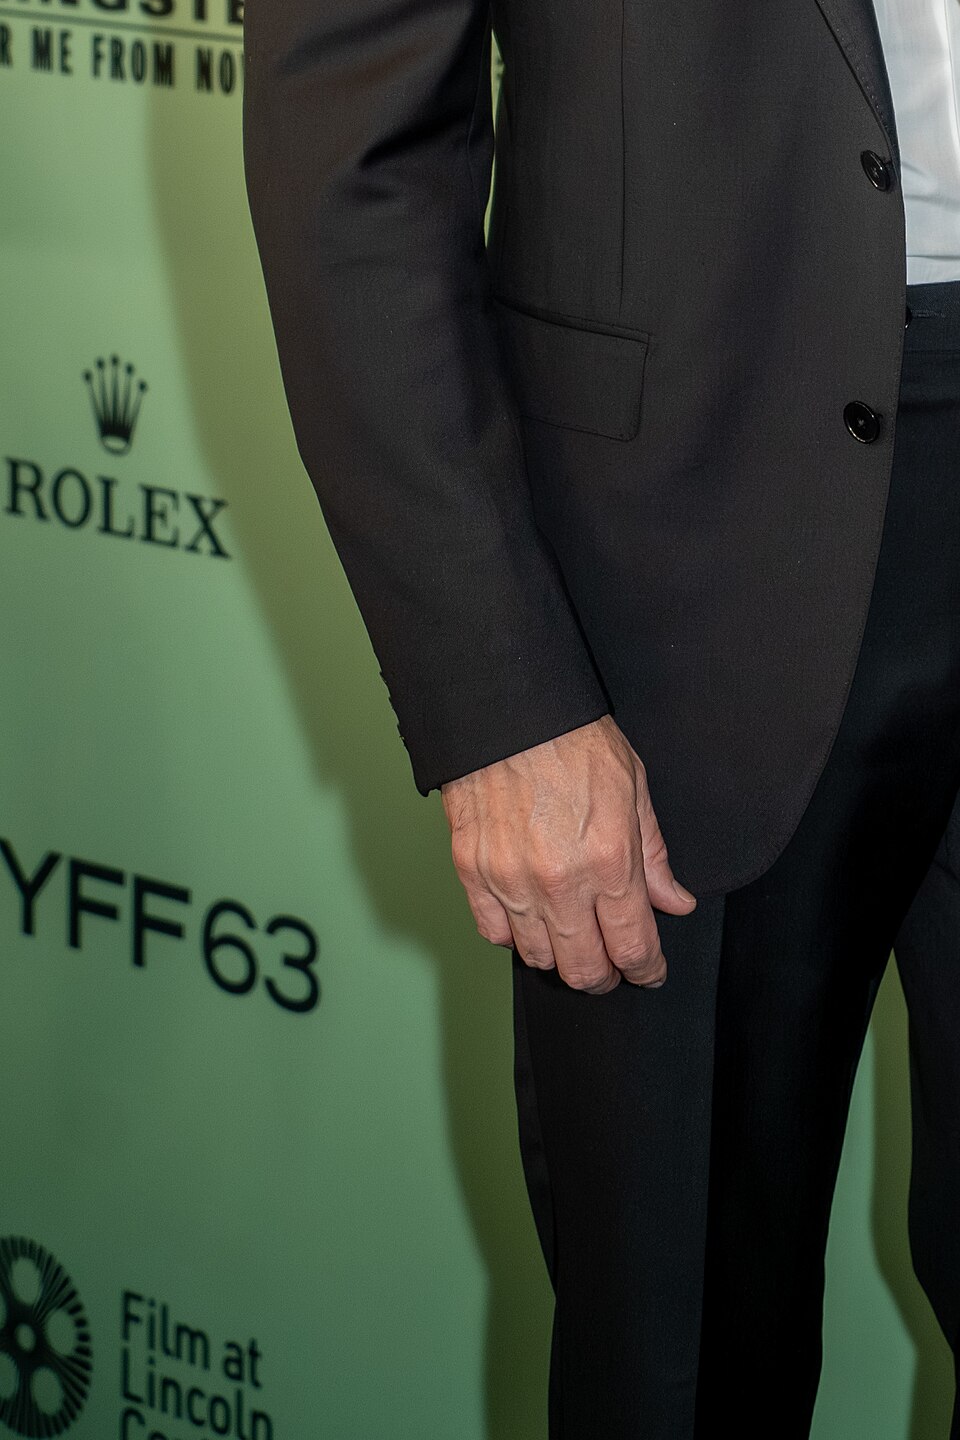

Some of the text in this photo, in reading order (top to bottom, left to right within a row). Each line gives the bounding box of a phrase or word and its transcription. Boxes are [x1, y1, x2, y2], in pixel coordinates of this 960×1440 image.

[31, 26, 73, 75] ME
[92, 33, 175, 88] FROM
[5, 456, 231, 561] ROLEX
[121, 1290, 262, 1390] Film at
[122, 1347, 273, 1440] Lincoln
